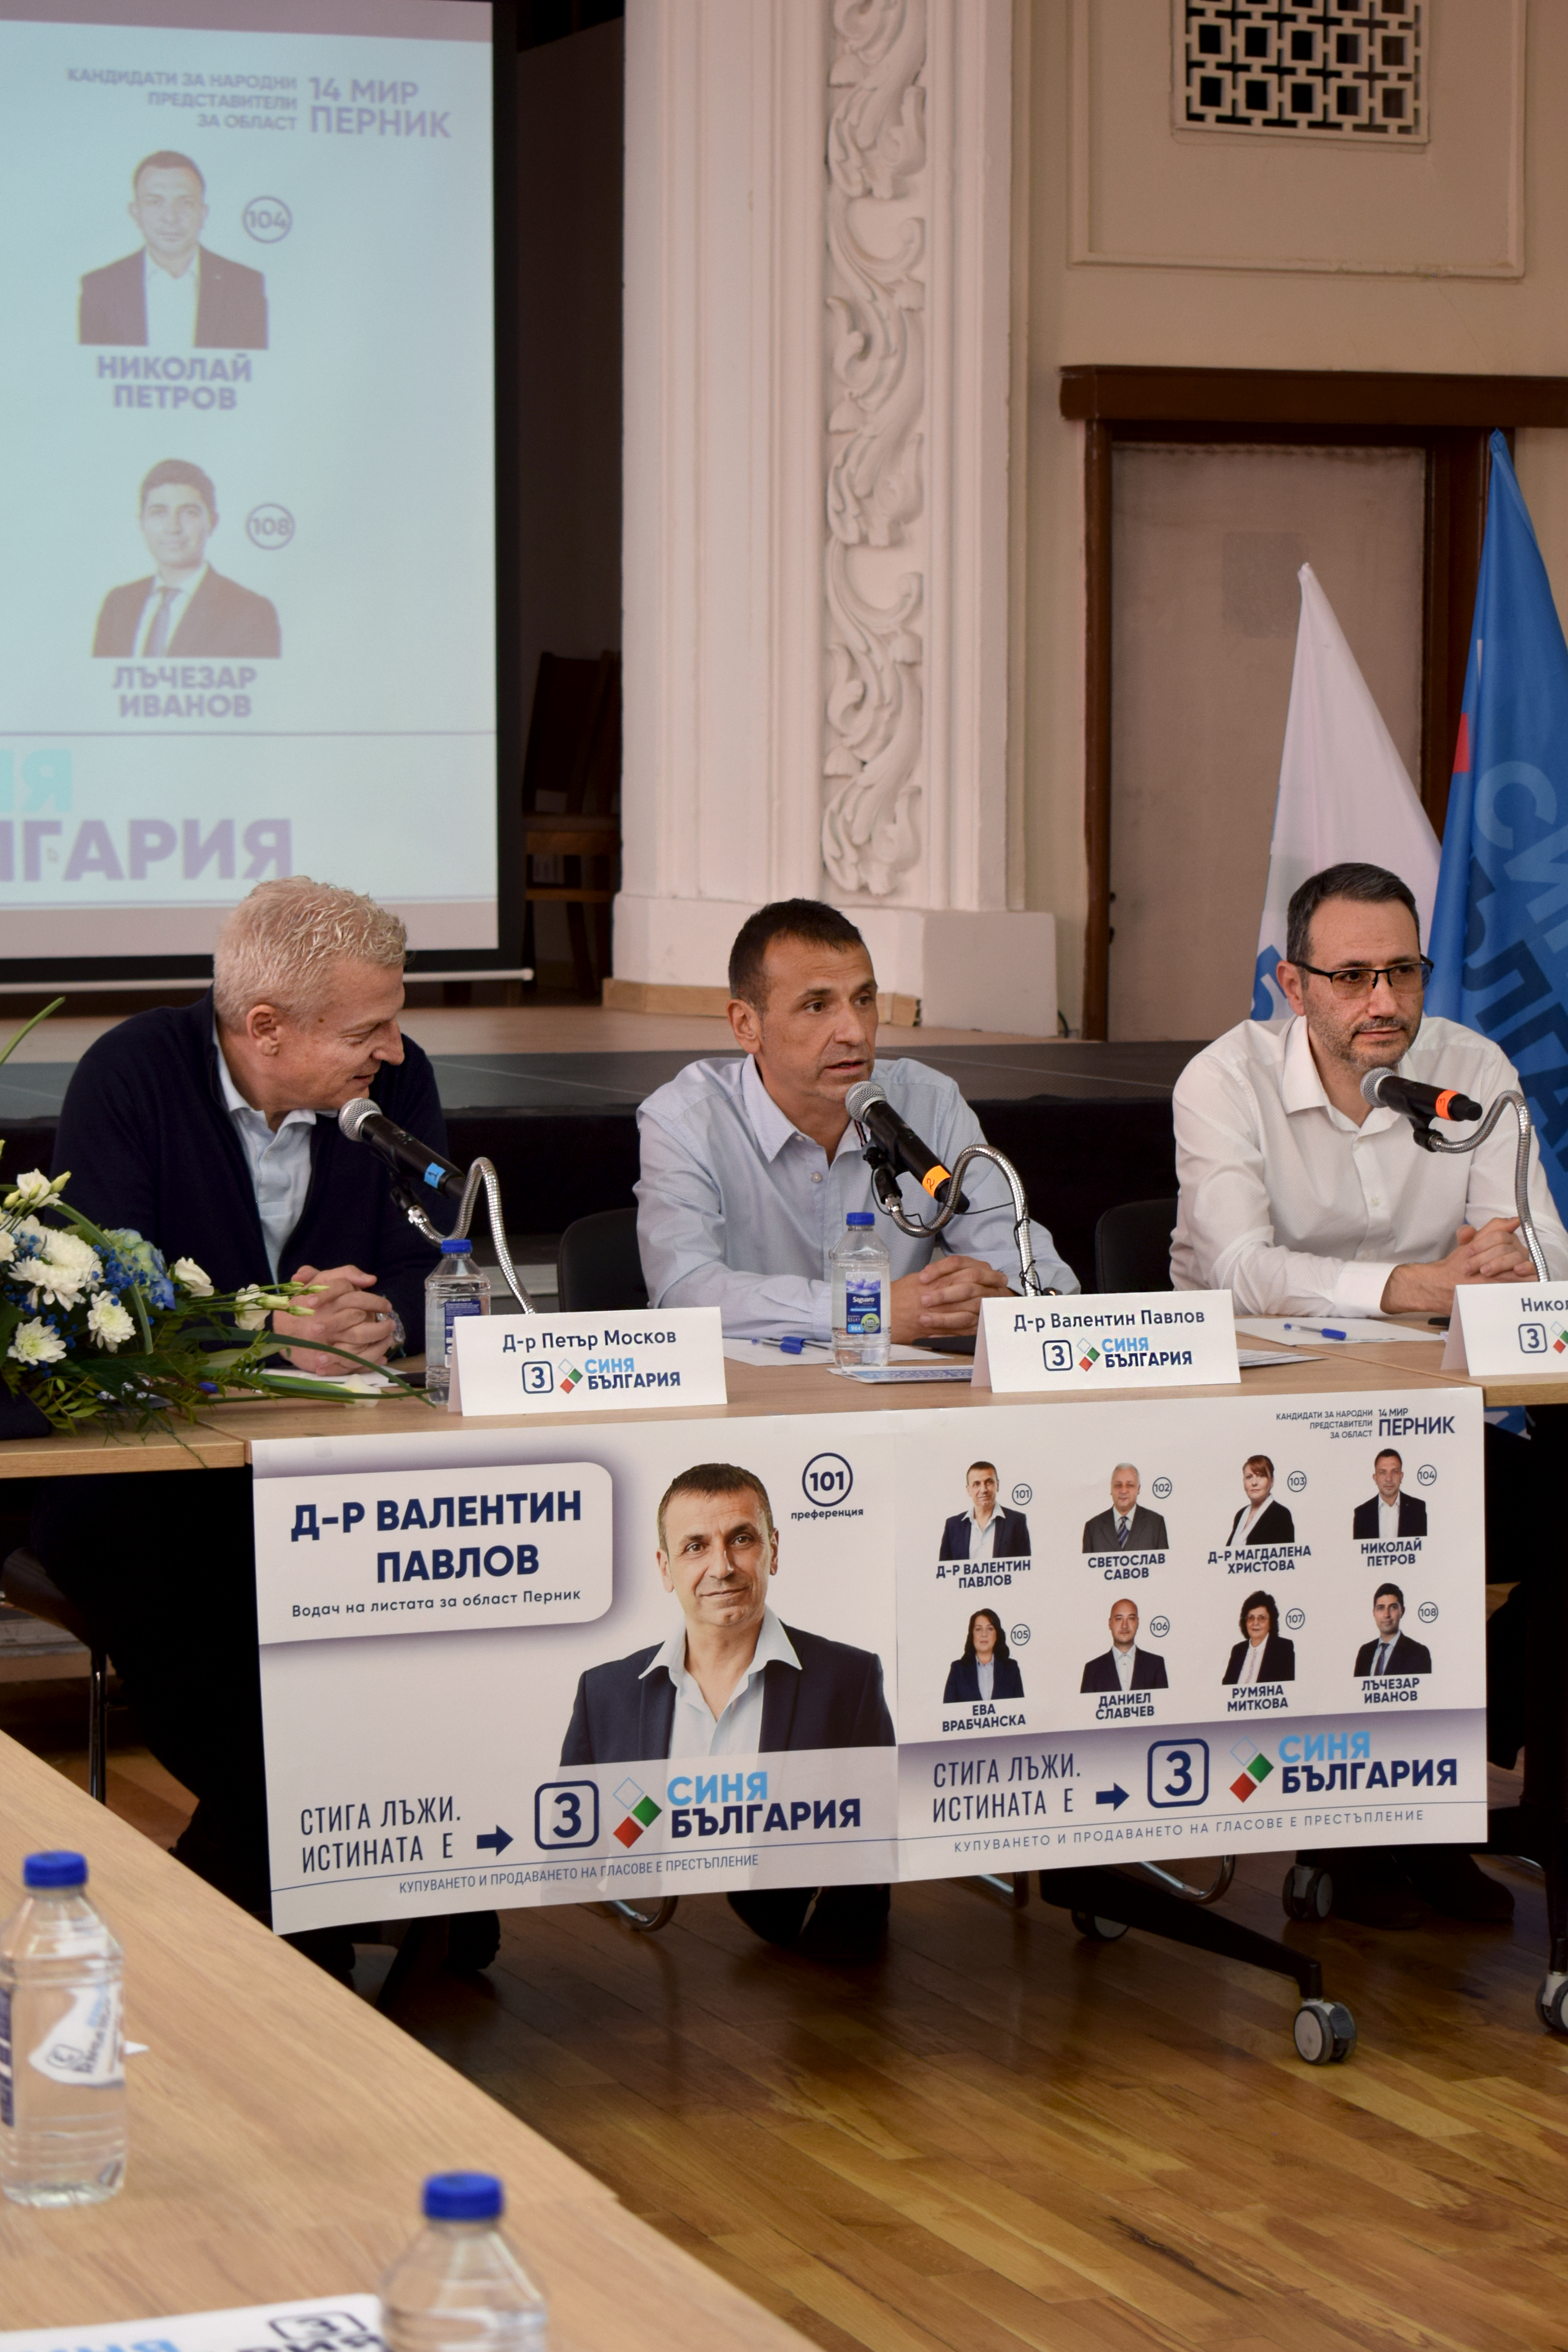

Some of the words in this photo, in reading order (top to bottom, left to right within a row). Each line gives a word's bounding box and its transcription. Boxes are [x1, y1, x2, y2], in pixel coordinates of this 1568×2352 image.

[68, 69, 177, 87] КАНДИДАТИ
[182, 74, 204, 87] ЗА
[210, 75, 297, 90] НАРОДНИ
[310, 78, 341, 101] 14
[351, 79, 418, 104] МИР
[148, 92, 297, 110] ПРЕДСТАВИТЕЛИ
[197, 113, 220, 128] ЗА
[224, 114, 297, 131] ОБЛАСТ
[310, 106, 451, 138] ПЕРНИК
[248, 210, 287, 229] 104
[98, 354, 252, 382] НИКОЛАЙ
[113, 385, 238, 410] ПЕТРОВ
[252, 518, 290, 535] 108
[113, 666, 257, 690] ЛЪЧЕЗАР
[119, 695, 252, 718] ИВАНОВ
[1014, 1314, 1045, 1332] Д-р
[1051, 1313, 1135, 1328] Валентин
[1141, 1310, 1205, 1325] Павлов
[503, 1334, 536, 1353] Д-р
[542, 1332, 598, 1350] Петър
[604, 1330, 676, 1346] Москов
[1102, 1337, 1149, 1353] СИНЯ
[1527, 1328, 1540, 1348] 3
[1051, 1345, 1065, 1366] 3
[1105, 1351, 1192, 1368] БЪЛГАРИЯ
[585, 1357, 634, 1374] СИНЯ
[531, 1367, 545, 1388] 3
[588, 1372, 681, 1390] БЪЛГАРИЯ
[1276, 1412, 1323, 1421] КАНДИДАТИ
[1336, 1409, 1373, 1418] НАРОДНИ
[1378, 1409, 1387, 1417] 14
[1389, 1408, 1408, 1417] МИР
[1310, 1419, 1372, 1430] ПРЕДСТАВИТЕЛИ
[1379, 1416, 1455, 1436] ПЕРНИК
[1341, 1430, 1372, 1438] ОБЛАСТ
[809, 1471, 844, 1492] 101
[1290, 1477, 1305, 1486] 103
[1419, 1471, 1435, 1480] 104
[1015, 1490, 1030, 1499] 101
[1154, 1483, 1171, 1492] 102
[291, 1502, 365, 1542] Д-Р
[377, 1490, 581, 1531] ВАЛЕНТИН
[791, 1509, 864, 1521] преференция
[1208, 1550, 1232, 1564] Д-Р
[1235, 1545, 1311, 1561] МАГДАЛЕНА
[1361, 1537, 1421, 1554] НИКОЛАЙ
[377, 1544, 539, 1583] ПАВЛОВ
[936, 1564, 960, 1579] Д-Р
[964, 1559, 1031, 1575] ВАЛЕНТИН
[1088, 1553, 1165, 1568] СВЕТОСЛАВ
[1228, 1559, 1295, 1574] ХРИСТОВА
[1367, 1553, 1416, 1567] ПЕТРОВ
[959, 1574, 1012, 1588] ПАВЛОВ
[1104, 1567, 1149, 1581] САВОВ
[292, 1605, 339, 1618] Водач
[346, 1604, 365, 1613] на
[370, 1599, 434, 1612] листата
[440, 1598, 457, 1608] за
[463, 1593, 517, 1606] област
[523, 1590, 580, 1604] Перник
[1420, 1608, 1437, 1617] 108
[1152, 1622, 1168, 1631] 106
[1287, 1615, 1303, 1623] 107
[1013, 1630, 1029, 1639] 105
[1232, 1684, 1284, 1699] РУМЯНА
[1361, 1677, 1420, 1691] ЛЪЧЕЗАР
[1098, 1692, 1151, 1709] ДАНИЕЛ
[1227, 1697, 1288, 1712] МИТКОВА
[1364, 1690, 1417, 1704] ИВАНОВ
[972, 1703, 996, 1716] ЕВА
[1096, 1705, 1154, 1720] СЛАВЧЕВ
[942, 1714, 1026, 1732] ВРАБЧАНСКА
[1279, 1730, 1370, 1763] СИНЯ
[934, 1759, 999, 1788] СТИГА
[1008, 1753, 1080, 1782] ЛЪЖИ.
[1165, 1750, 1192, 1797] 3
[1282, 1759, 1457, 1794] БЪЛГАРИЯ
[667, 1771, 767, 1806] СИНЯ
[933, 1790, 1046, 1823] ИСТИНАТА
[1064, 1788, 1073, 1813] Е
[301, 1803, 371, 1835] СТИГА
[380, 1796, 460, 1827] ЛЪЖИ.
[553, 1792, 582, 1838] 3
[671, 1798, 860, 1838] БЪЛГАРИЯ
[955, 1835, 1050, 1853] КУПУВАНЕТО
[1058, 1834, 1065, 1844] И
[1074, 1825, 1183, 1843] ПРОДАВАНЕТО
[1191, 1823, 1209, 1834] НА
[1216, 1817, 1283, 1832] ГЛАСОВЕ
[1290, 1817, 1297, 1827] Е
[1305, 1810, 1423, 1826] ПРЕСТЪПЛЕНИЕ
[302, 1835, 423, 1873] ИСТИНАТА
[443, 1833, 453, 1858] Е
[399, 1875, 475, 1893] КУПУВАНЕТО
[479, 1875, 487, 1886] И
[491, 1867, 578, 1886] ПРОДАВАНЕТО
[581, 1866, 597, 1878] НА
[600, 1862, 652, 1877] ГЛАСОВЕ
[656, 1861, 662, 1873] Е
[666, 1854, 759, 1871] ПРЕСТЪПЛЕНИЕ
